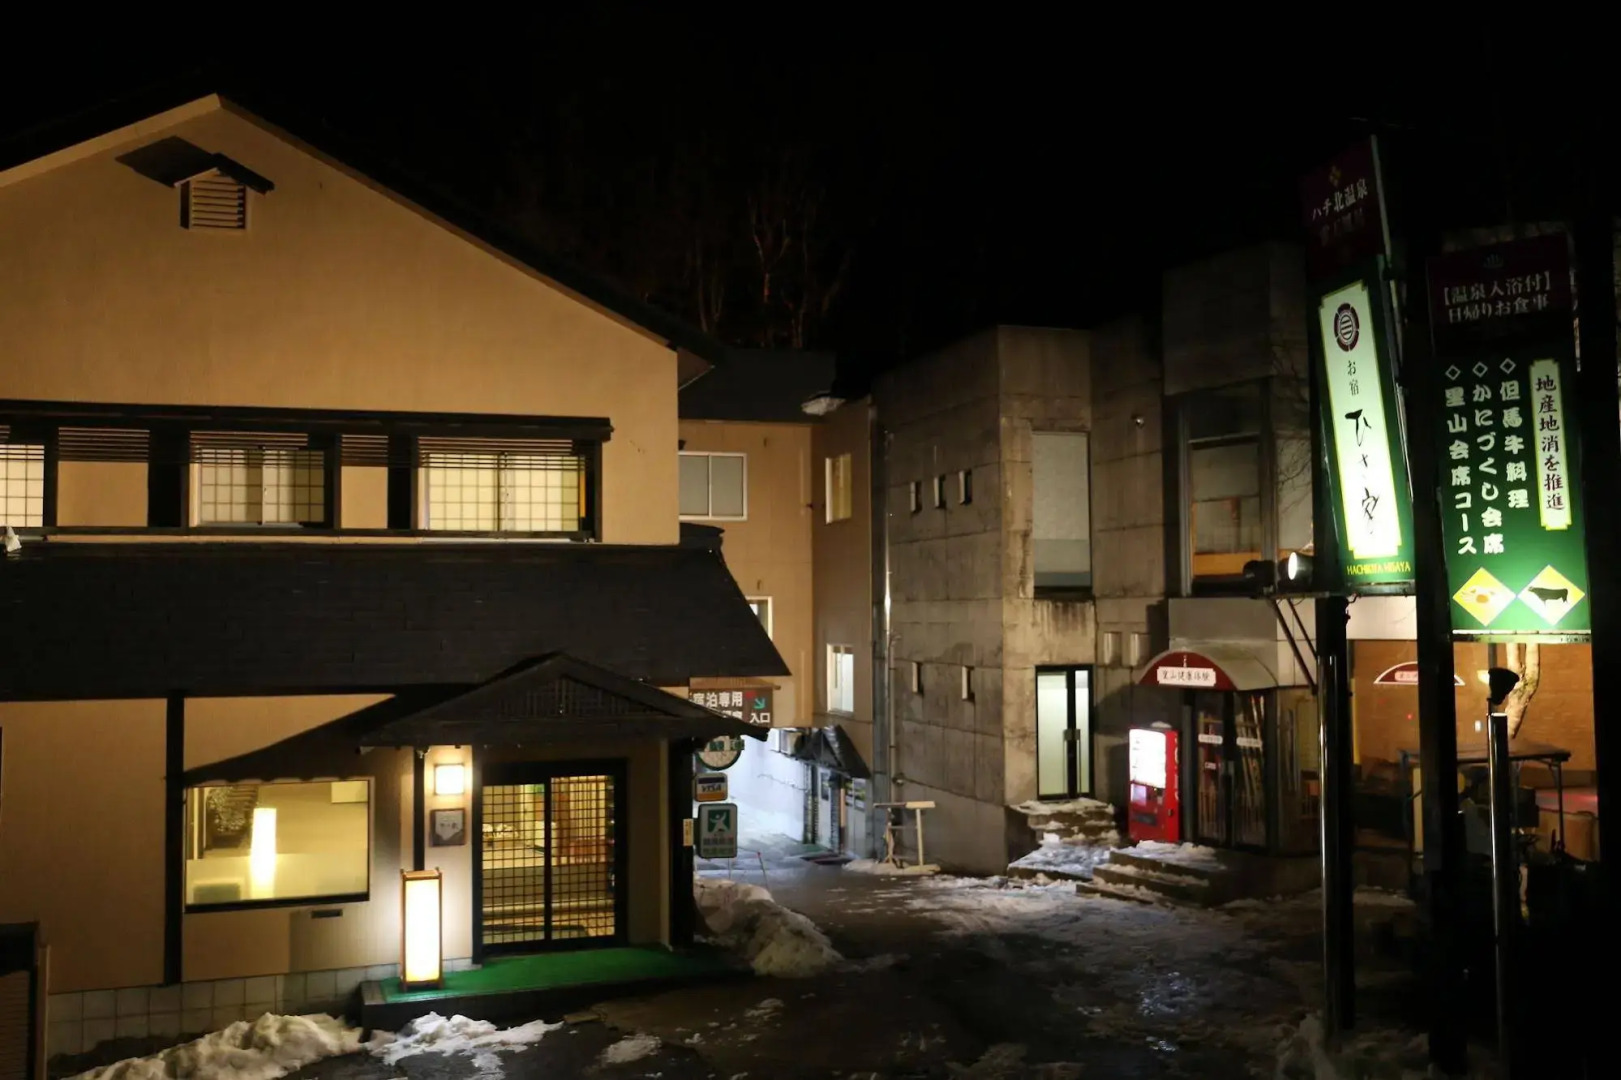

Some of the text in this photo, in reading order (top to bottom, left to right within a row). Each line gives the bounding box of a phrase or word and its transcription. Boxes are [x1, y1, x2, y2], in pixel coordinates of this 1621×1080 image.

[1347, 360, 1360, 396] お宿
[1535, 375, 1566, 511] 地産地消を推進
[1445, 386, 1477, 556] 里山会席コース
[1472, 384, 1505, 554] かにづくし会席
[1499, 380, 1530, 509] 但馬牛料理
[749, 713, 770, 723] 入口
